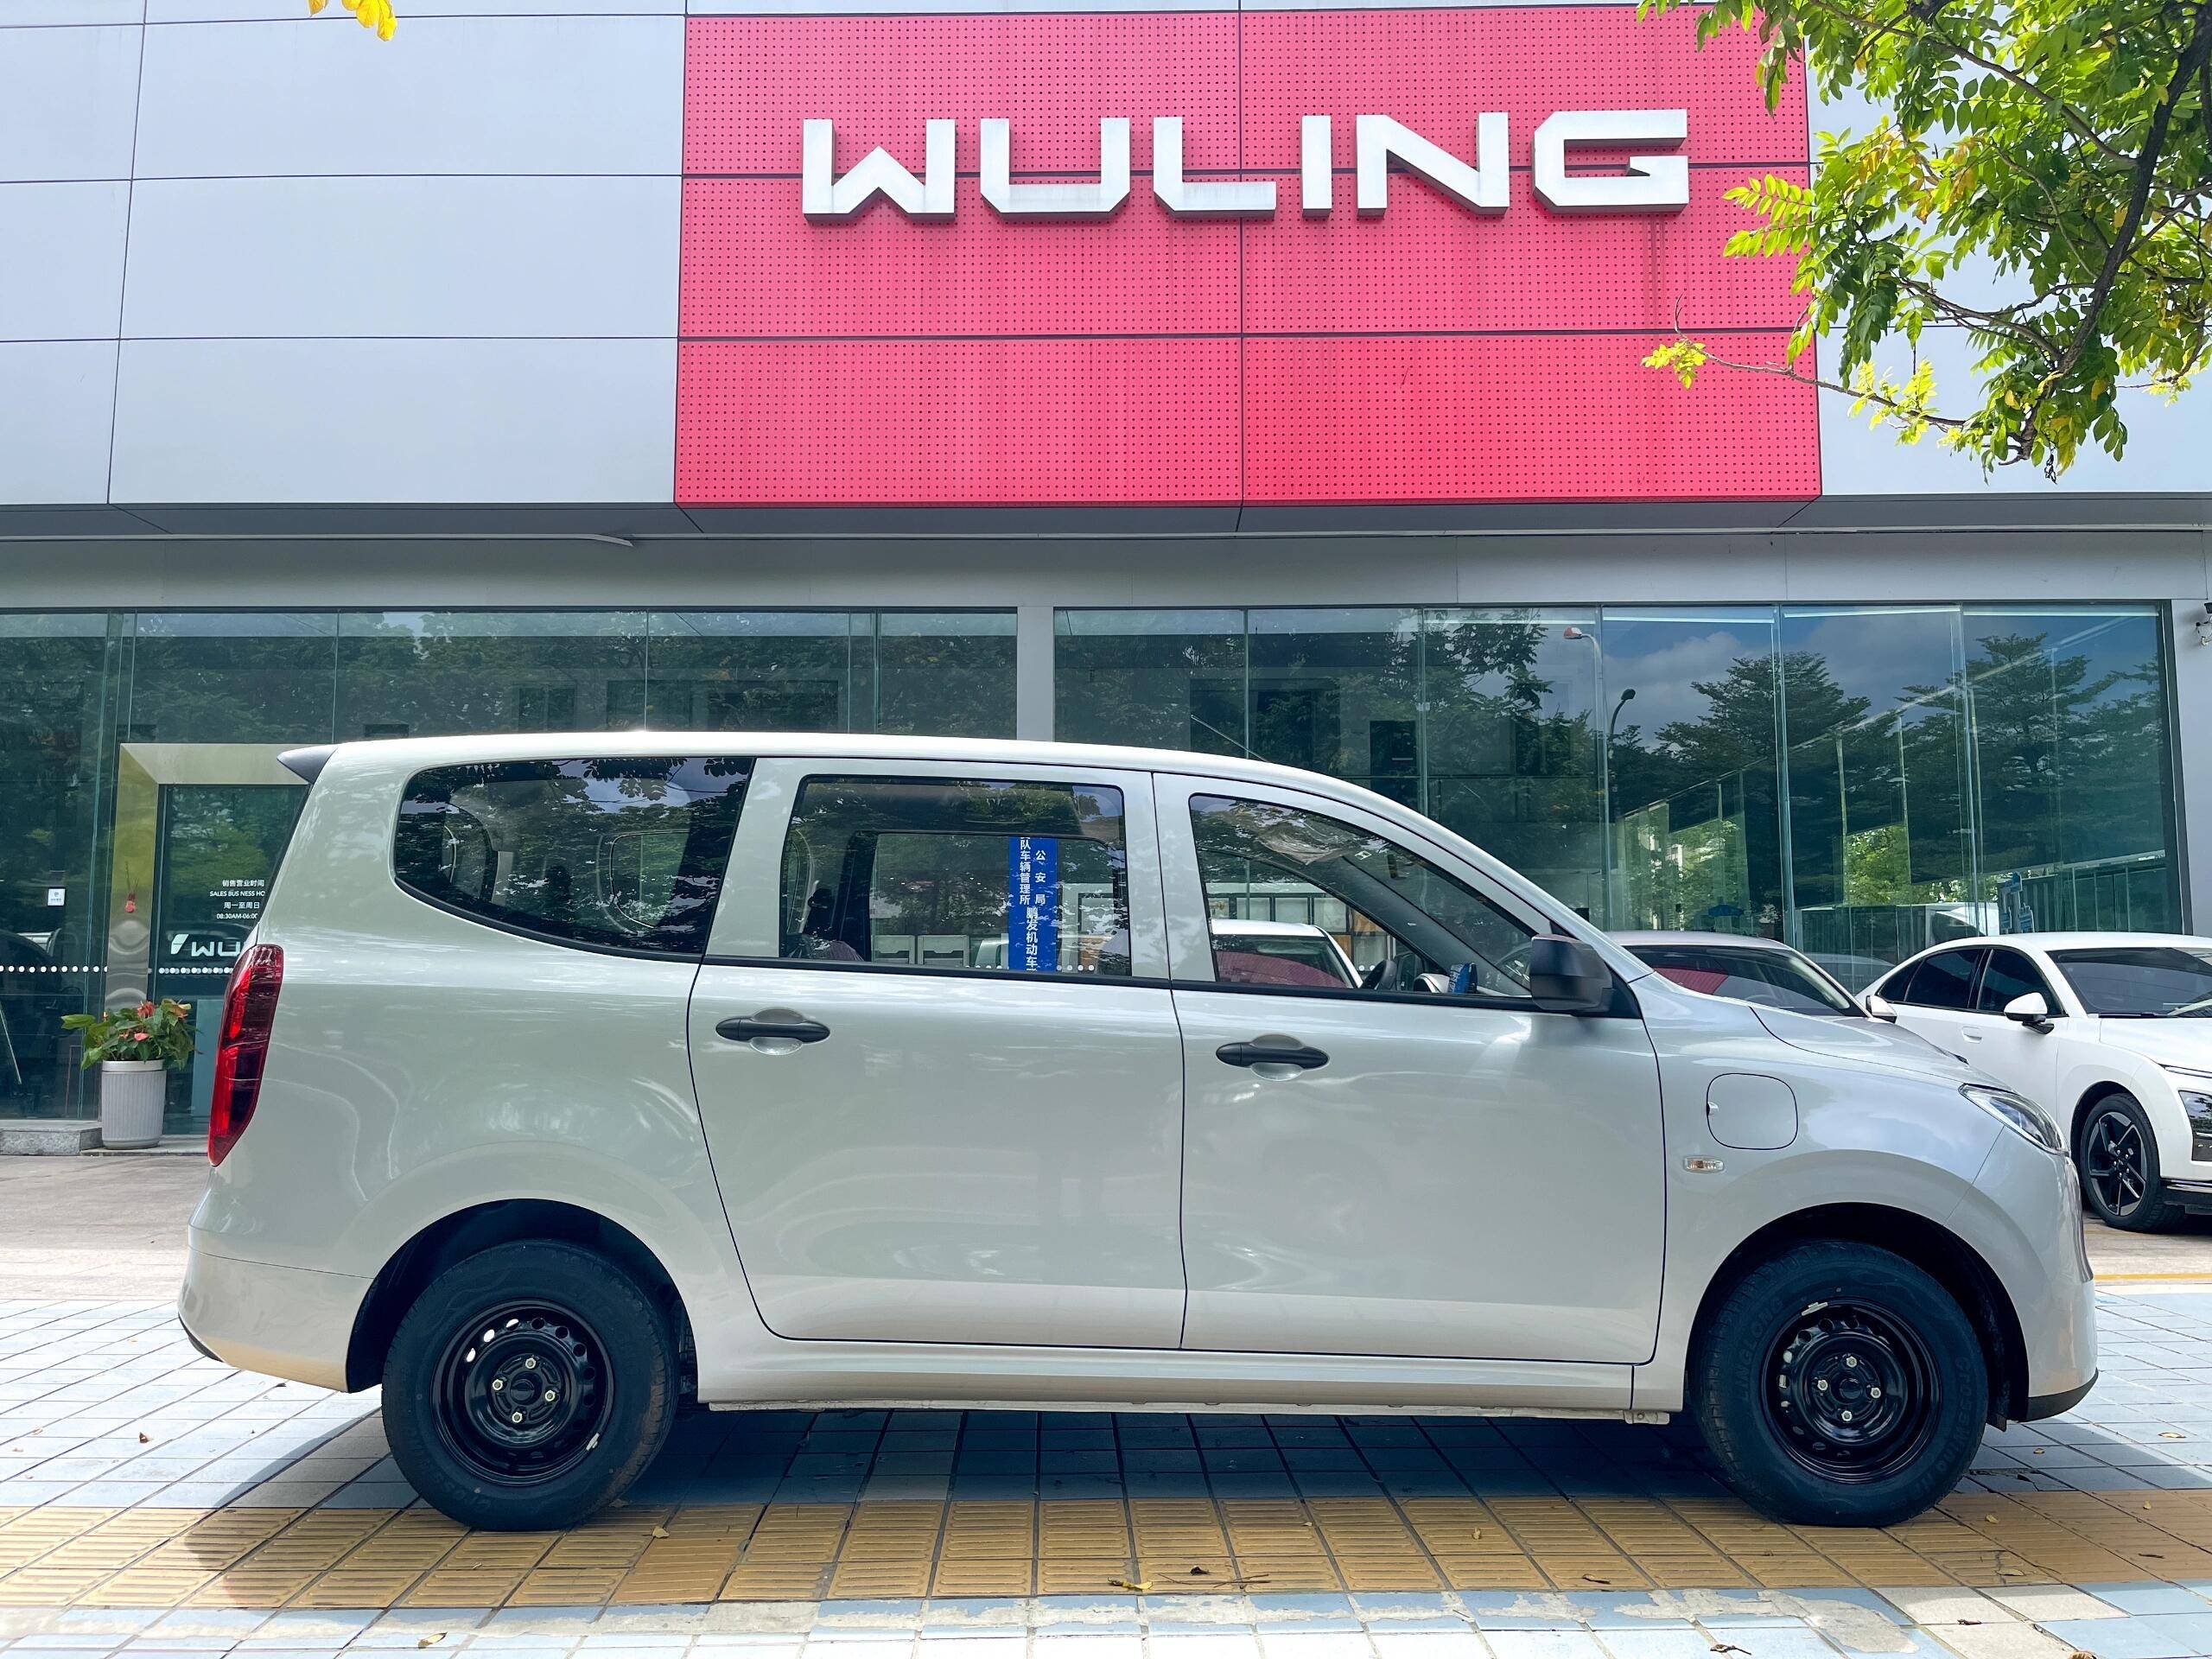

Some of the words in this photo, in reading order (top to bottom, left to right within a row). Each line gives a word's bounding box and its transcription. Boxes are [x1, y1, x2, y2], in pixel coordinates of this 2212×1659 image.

[802, 109, 1690, 220] WULING
[1020, 836, 1031, 906] 队车辆管理所
[1035, 849, 1046, 905] 公安局
[191, 941, 241, 957] WU
[1026, 906, 1039, 972] 鹏发机动车
